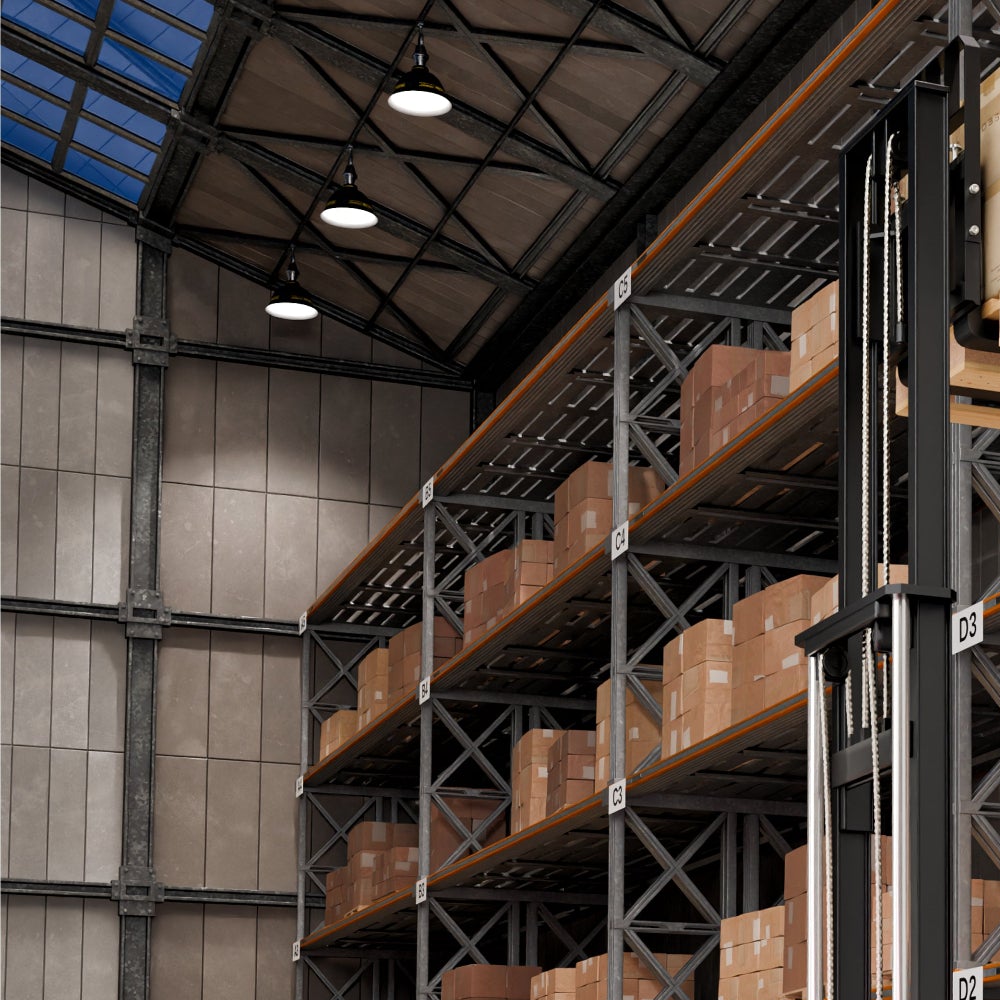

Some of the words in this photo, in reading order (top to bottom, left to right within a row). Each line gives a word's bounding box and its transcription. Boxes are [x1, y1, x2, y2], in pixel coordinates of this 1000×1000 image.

[619, 274, 628, 299] C5
[615, 528, 625, 551] C4
[959, 611, 977, 643] D3
[422, 681, 428, 698] B4
[613, 785, 622, 806] C3
[418, 882, 425, 898] B3
